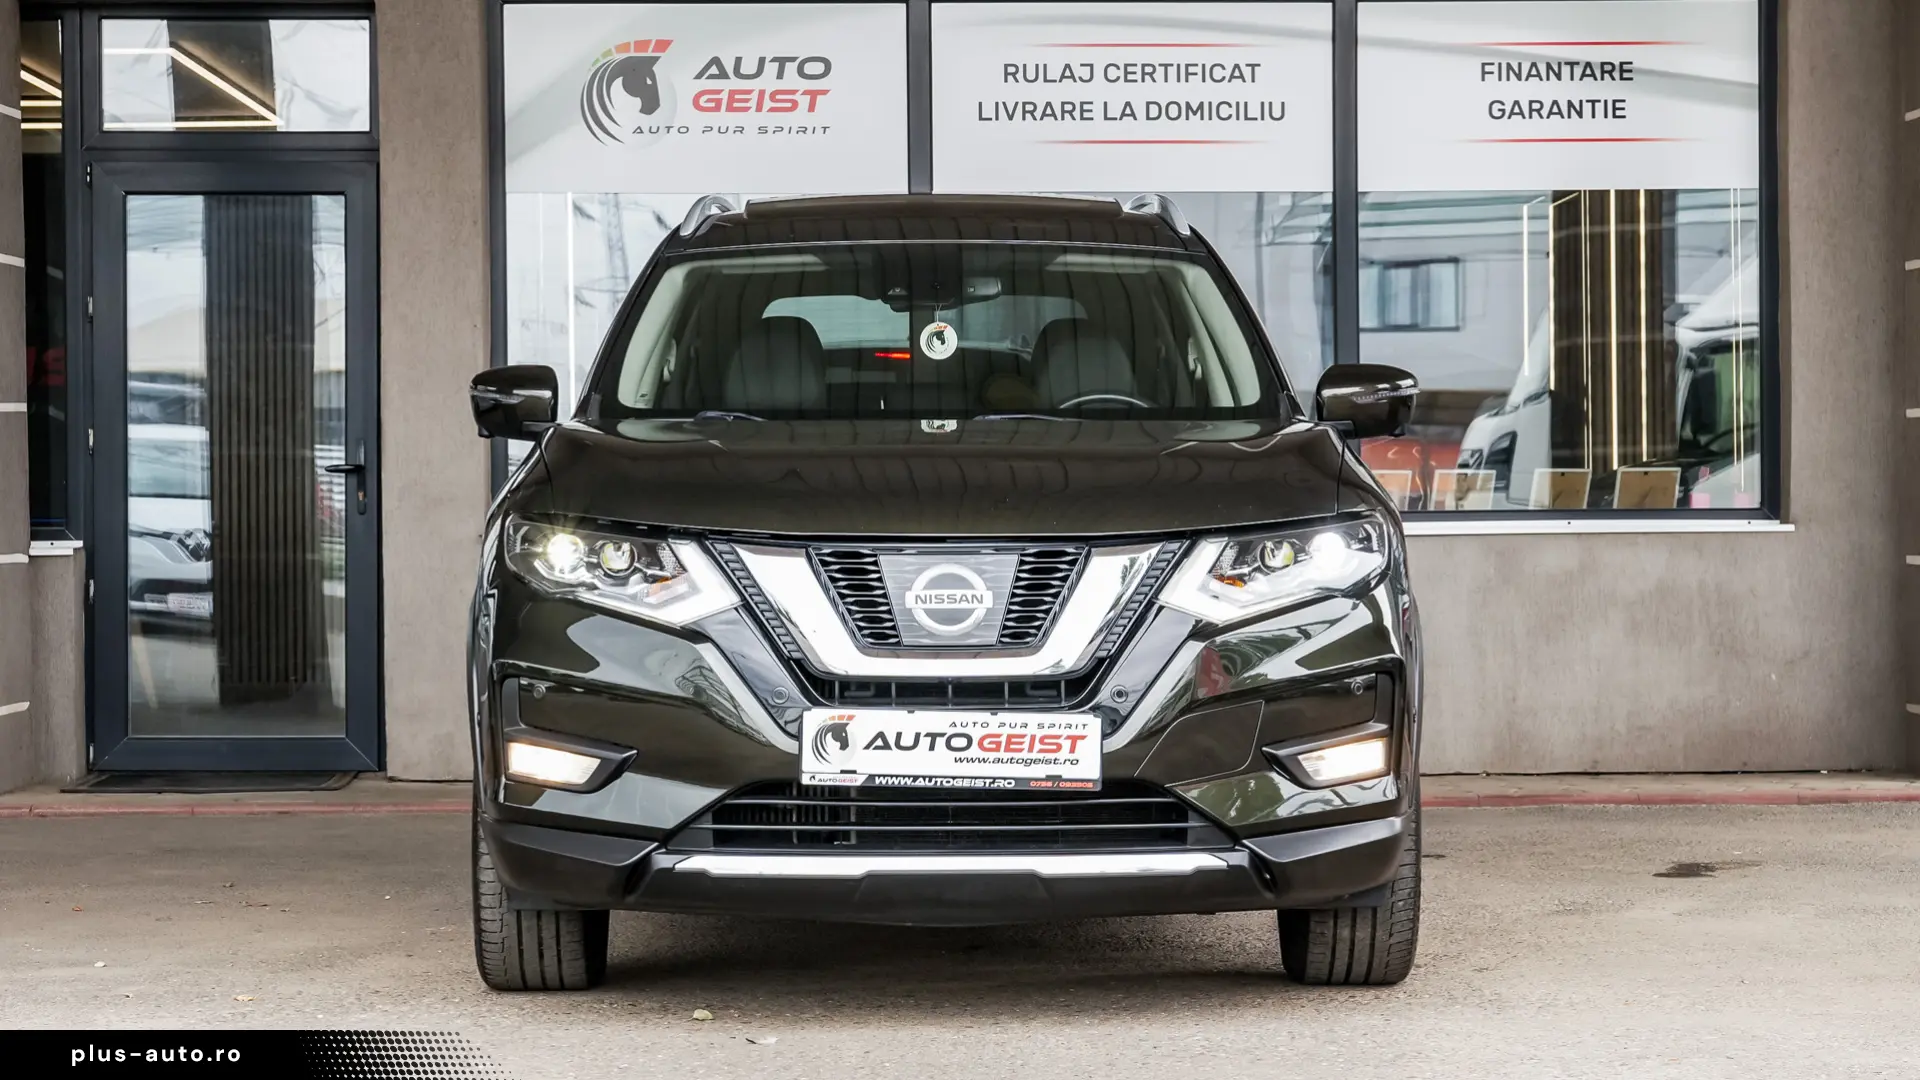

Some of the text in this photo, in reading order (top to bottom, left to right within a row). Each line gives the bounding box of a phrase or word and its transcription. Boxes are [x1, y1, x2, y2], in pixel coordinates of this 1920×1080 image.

[692, 55, 832, 80] AUTO
[1002, 62, 1261, 83] RULAJ CERTIFICAT
[1480, 60, 1634, 82] FINANTARE
[692, 88, 832, 113] GEIST
[977, 100, 1286, 121] LIVRARE LA DOMICILIU
[1487, 99, 1627, 120] GARANTIE
[632, 125, 831, 135] AUTO PUR SPIRIT
[914, 593, 984, 605] NISSAN
[949, 721, 1089, 731] AUTO PUR SPIRIT
[954, 755, 1080, 768] www.autogeist.ro
[874, 776, 1016, 788] WWW.AUTOGEIST.RO
